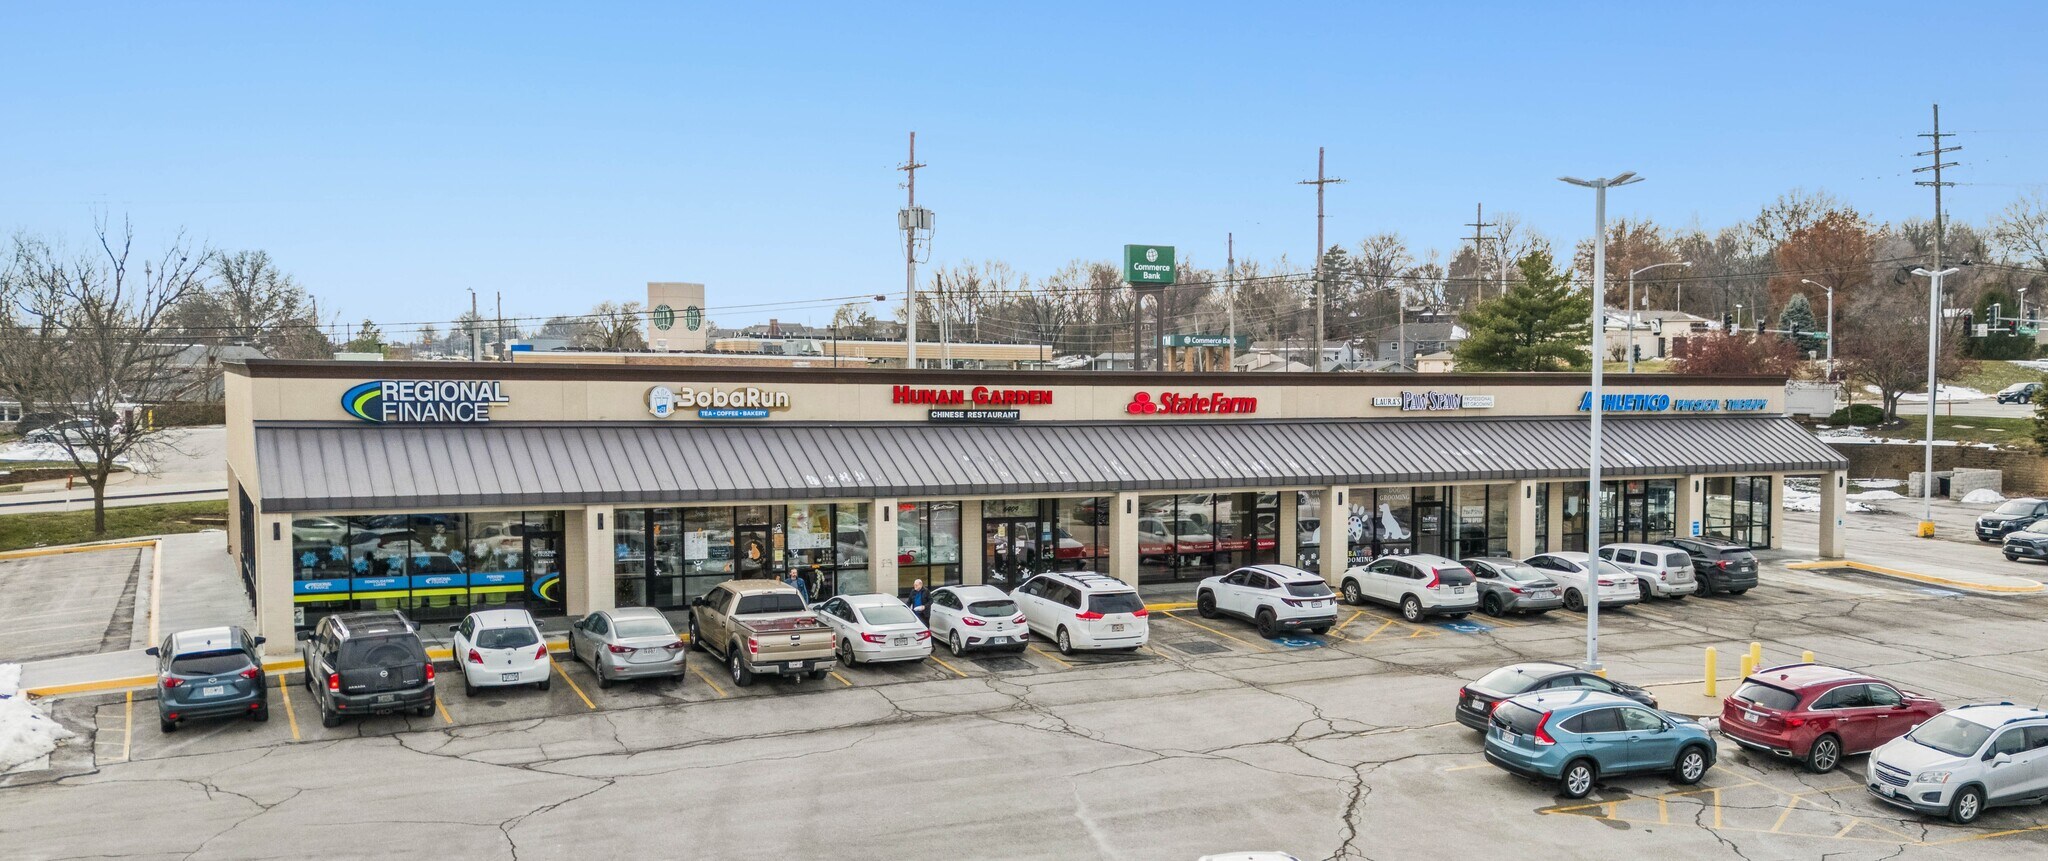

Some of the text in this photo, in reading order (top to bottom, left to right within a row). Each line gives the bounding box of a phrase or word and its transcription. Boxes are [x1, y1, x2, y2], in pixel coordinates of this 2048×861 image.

[1133, 263, 1170, 271] Commerce
[1143, 272, 1161, 280] Bank
[1162, 336, 1171, 346] TM
[381, 381, 509, 402] REGIONAL
[892, 386, 1053, 405] HUNAN GARDEN
[1375, 398, 1401, 406] LAURA'S
[1580, 391, 1670, 411] AHLETICO
[1677, 399, 1768, 411] PHYSICAL THERAPY
[382, 402, 490, 422] FINANCE
[931, 411, 1018, 419] CHINESE RESTAURANT
